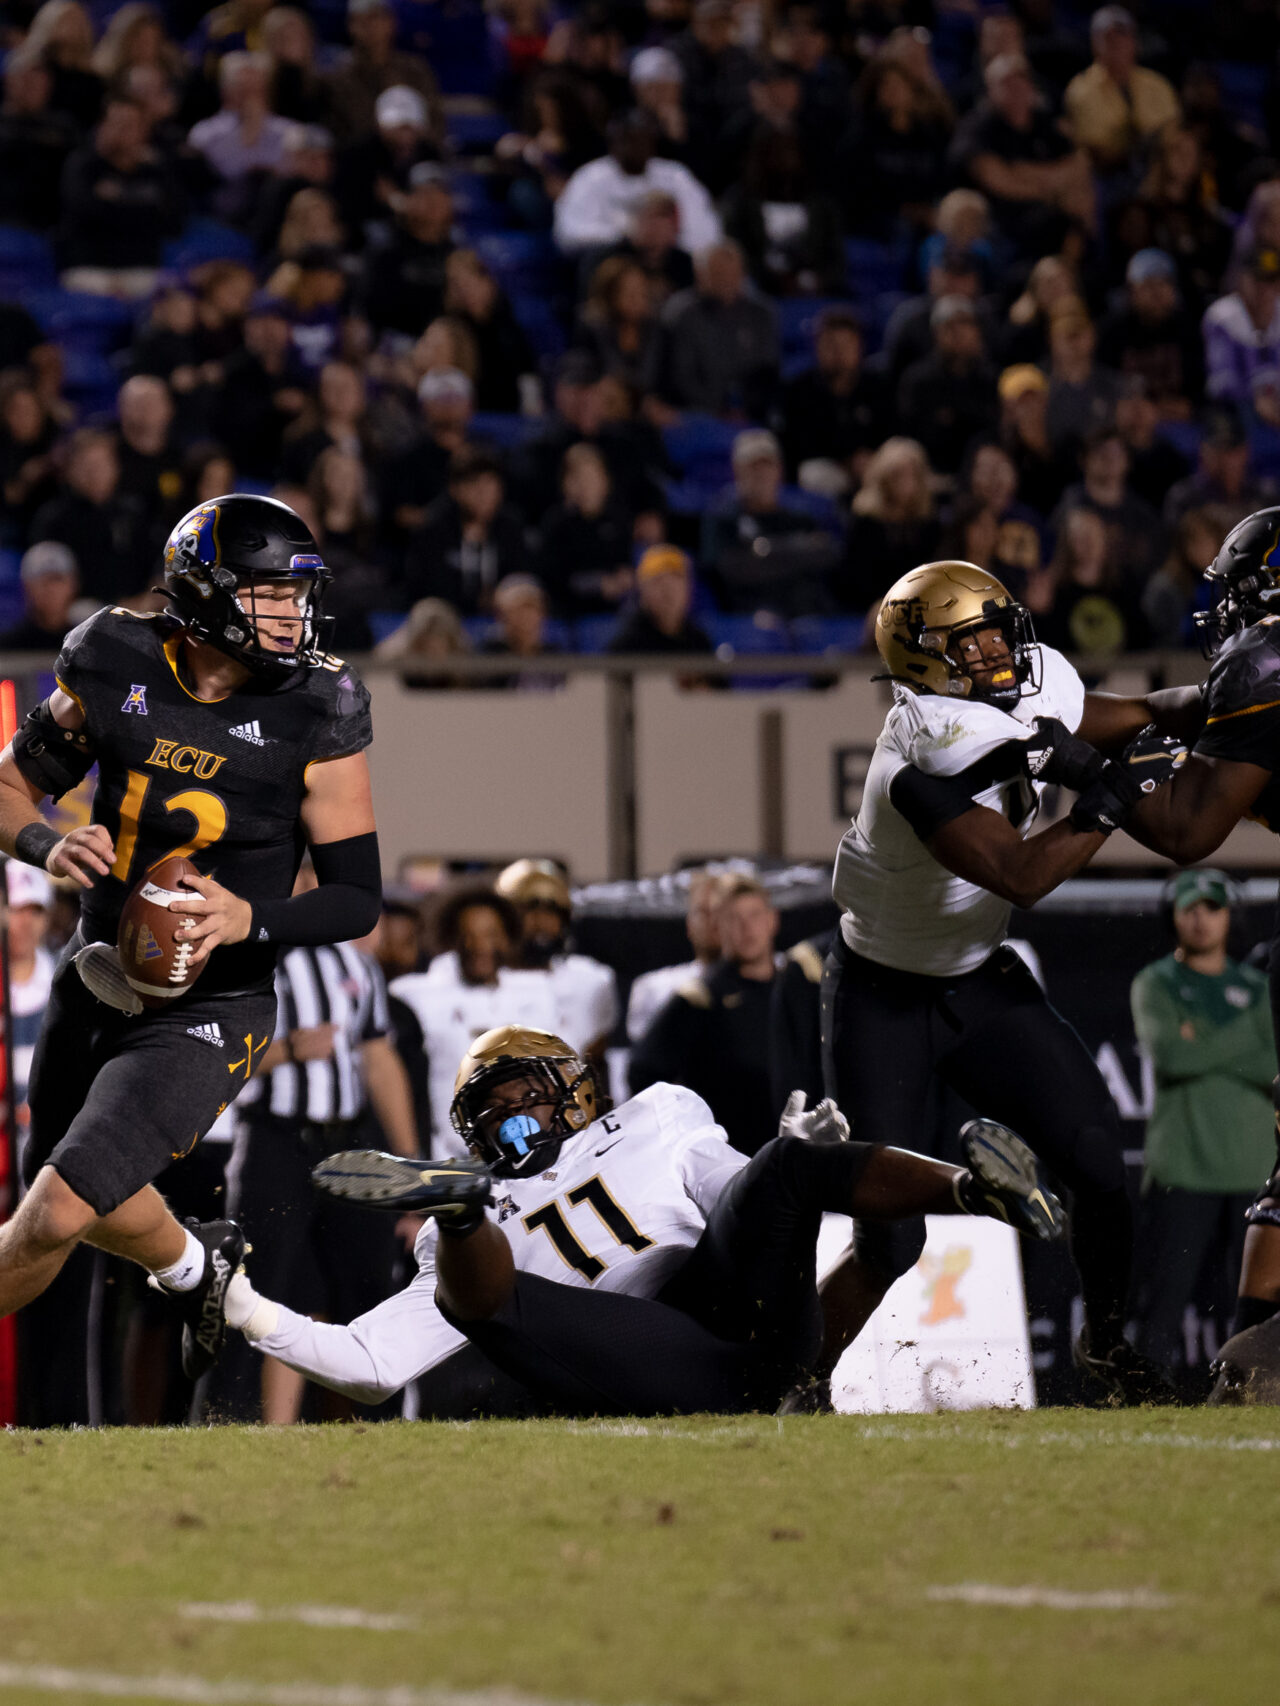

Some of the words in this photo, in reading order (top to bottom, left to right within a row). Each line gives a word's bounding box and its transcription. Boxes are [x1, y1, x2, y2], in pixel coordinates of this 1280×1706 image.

[121, 684, 148, 715] A
[144, 737, 228, 780] ECU
[1032, 746, 1054, 775] adidas
[111, 769, 230, 882] 12
[521, 1172, 658, 1286] 11
